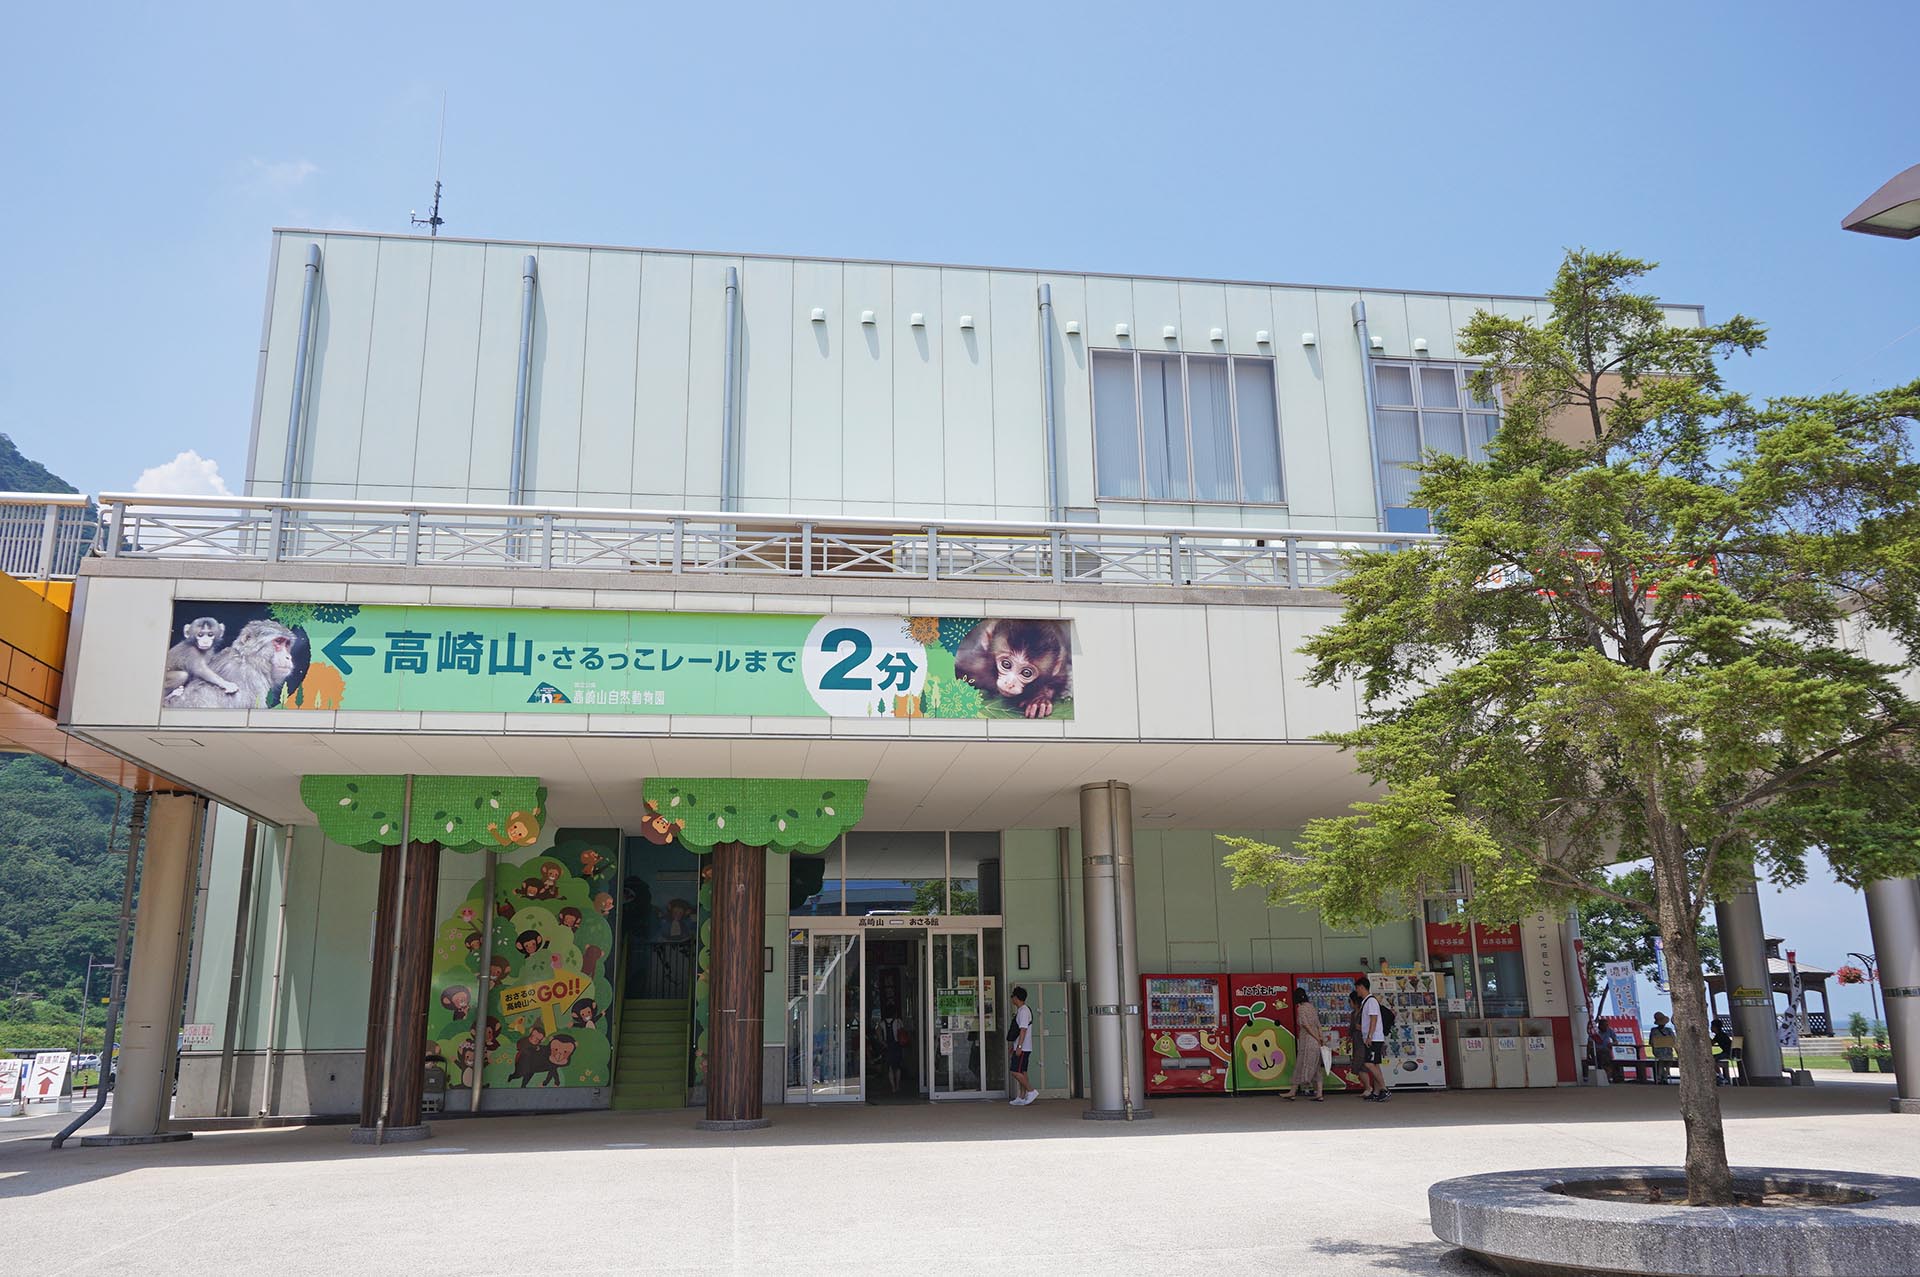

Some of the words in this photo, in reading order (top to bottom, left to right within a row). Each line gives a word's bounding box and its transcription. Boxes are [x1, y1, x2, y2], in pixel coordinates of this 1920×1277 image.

[384, 630, 797, 676] 高崎山・さるっこレールまで
[819, 628, 918, 691] 2分
[859, 918, 884, 927] 高崎山
[505, 988, 536, 1002] おさるの
[537, 978, 580, 1002] GO!!
